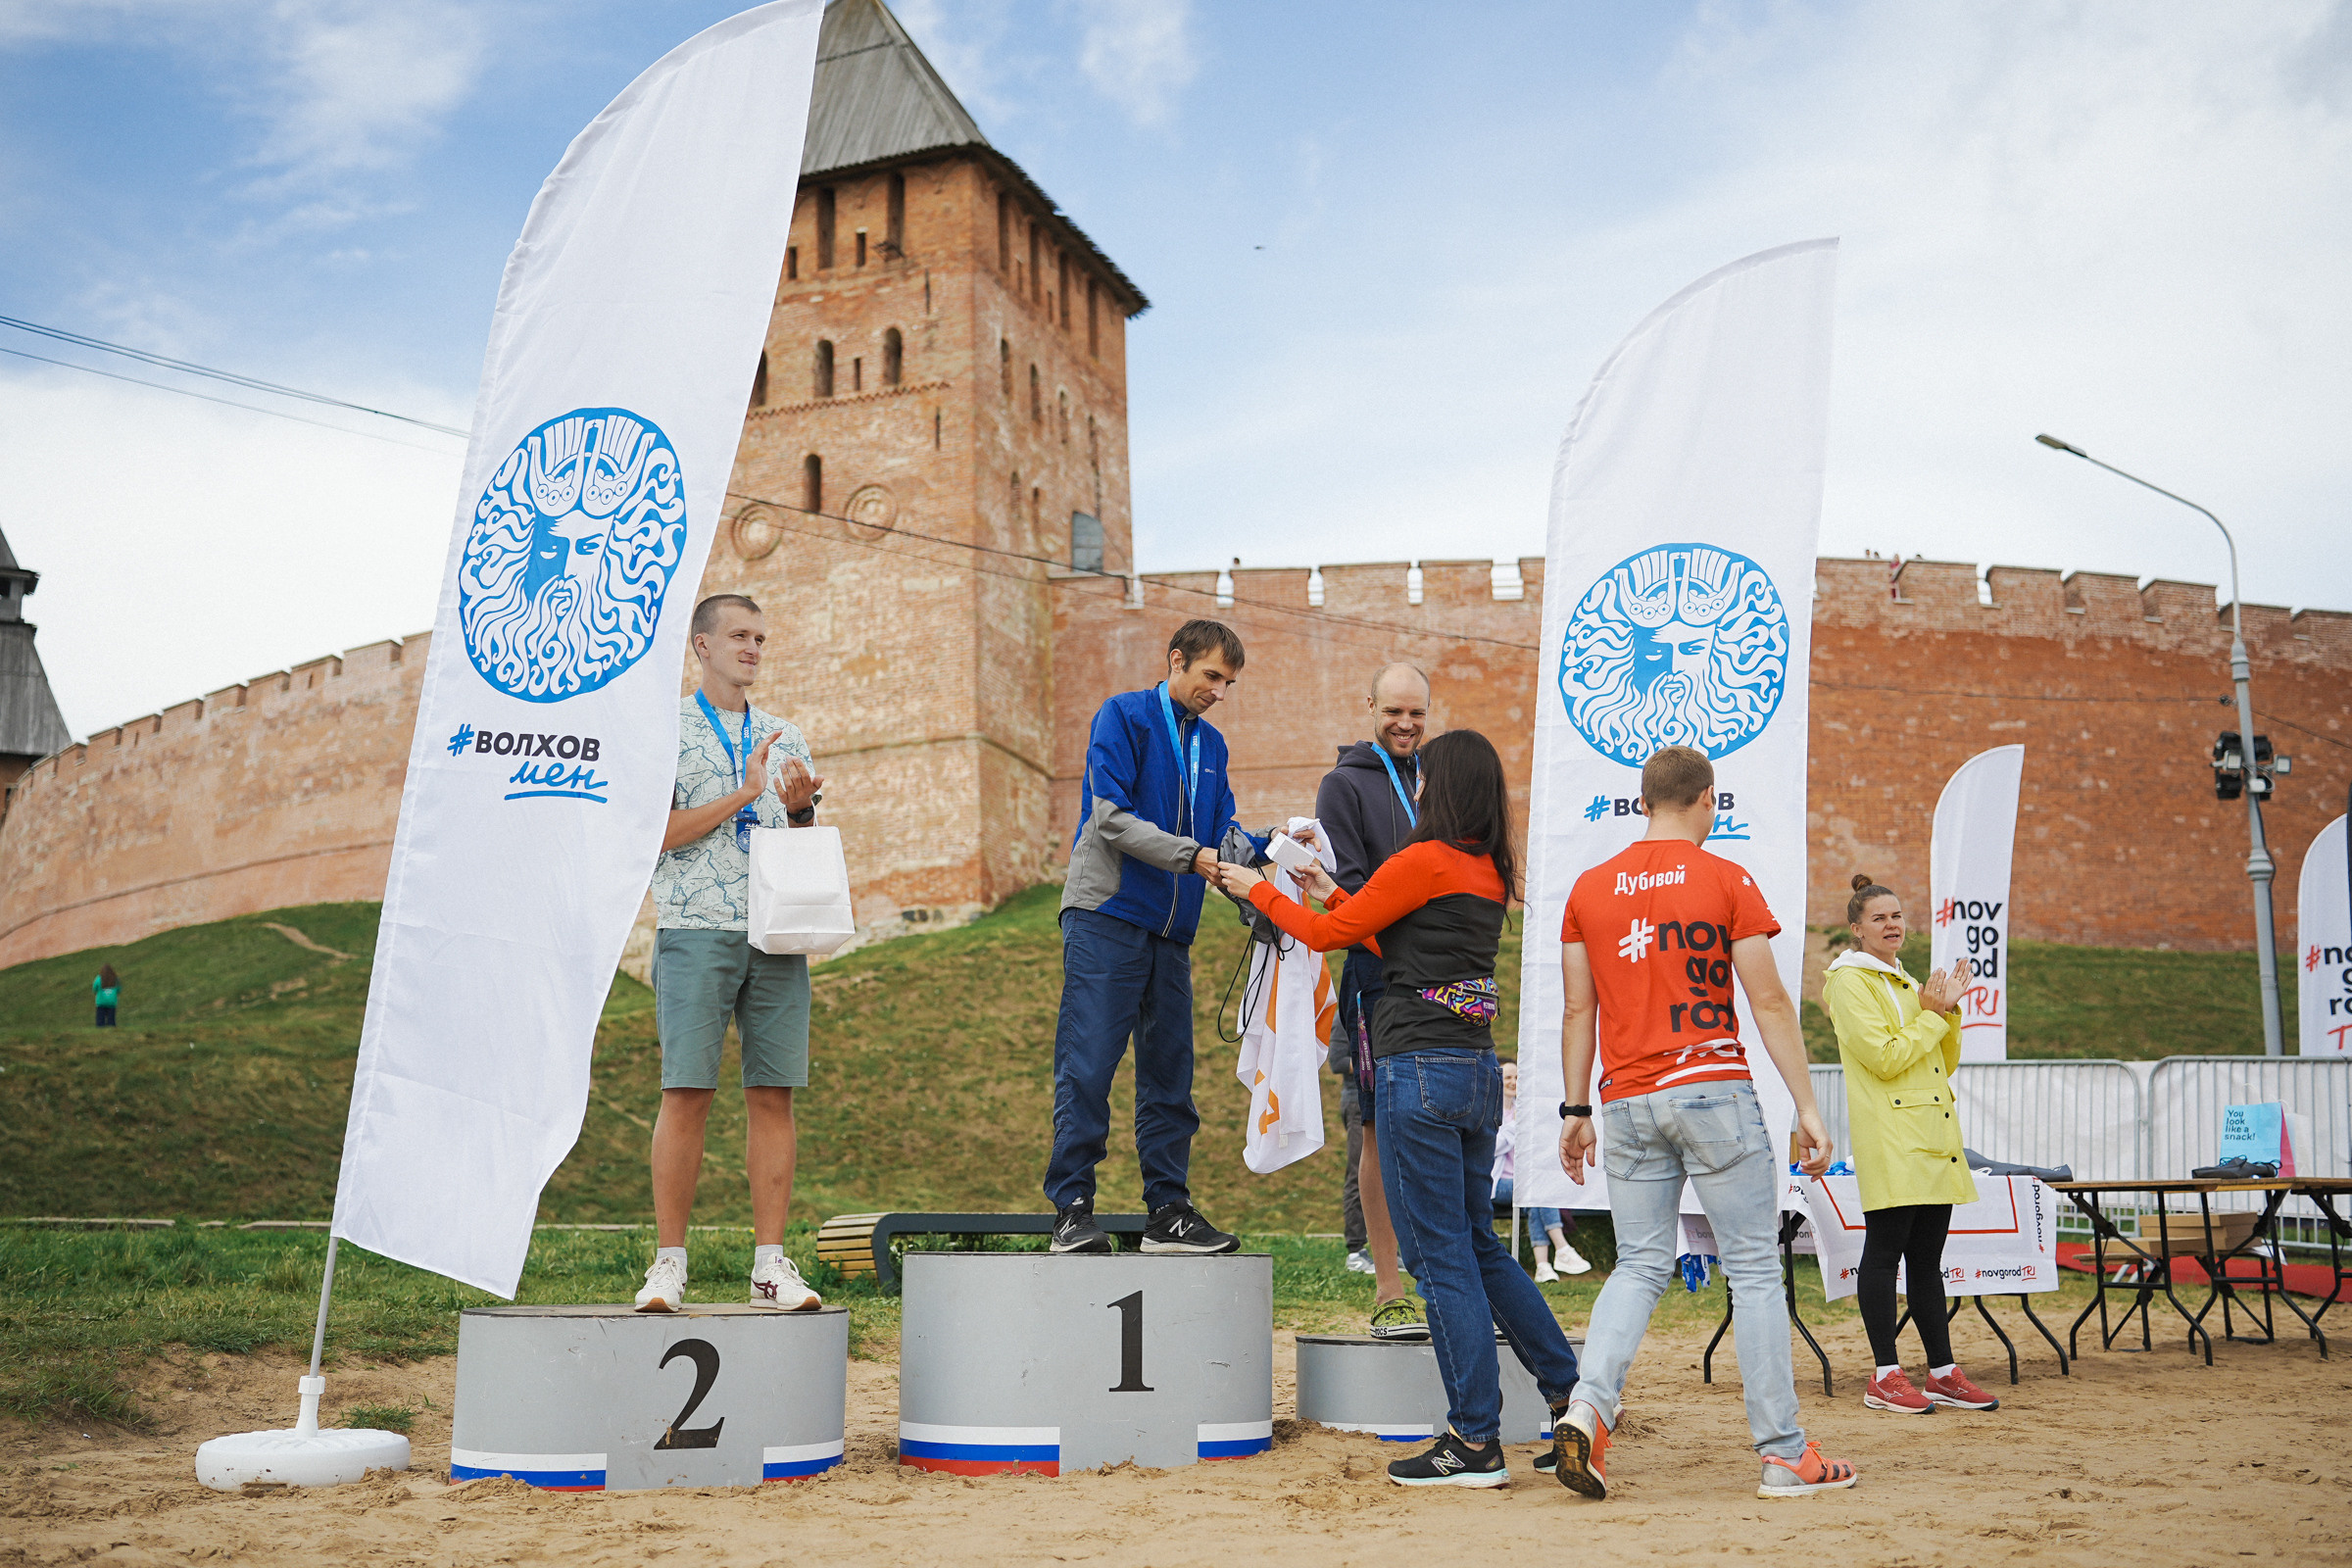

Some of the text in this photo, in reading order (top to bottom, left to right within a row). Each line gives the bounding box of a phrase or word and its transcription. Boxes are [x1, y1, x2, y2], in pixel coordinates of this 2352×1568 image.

[447, 723, 601, 761] #ВОЛХОВ
[1936, 897, 2002, 927] #nov
[1967, 925, 1999, 954] go
[1956, 948, 1998, 978] od
[1961, 986, 1999, 1016] TRI
[2224, 1132, 2256, 1141] snack!
[1106, 1290, 1154, 1392] 1
[654, 1338, 725, 1450] 2
